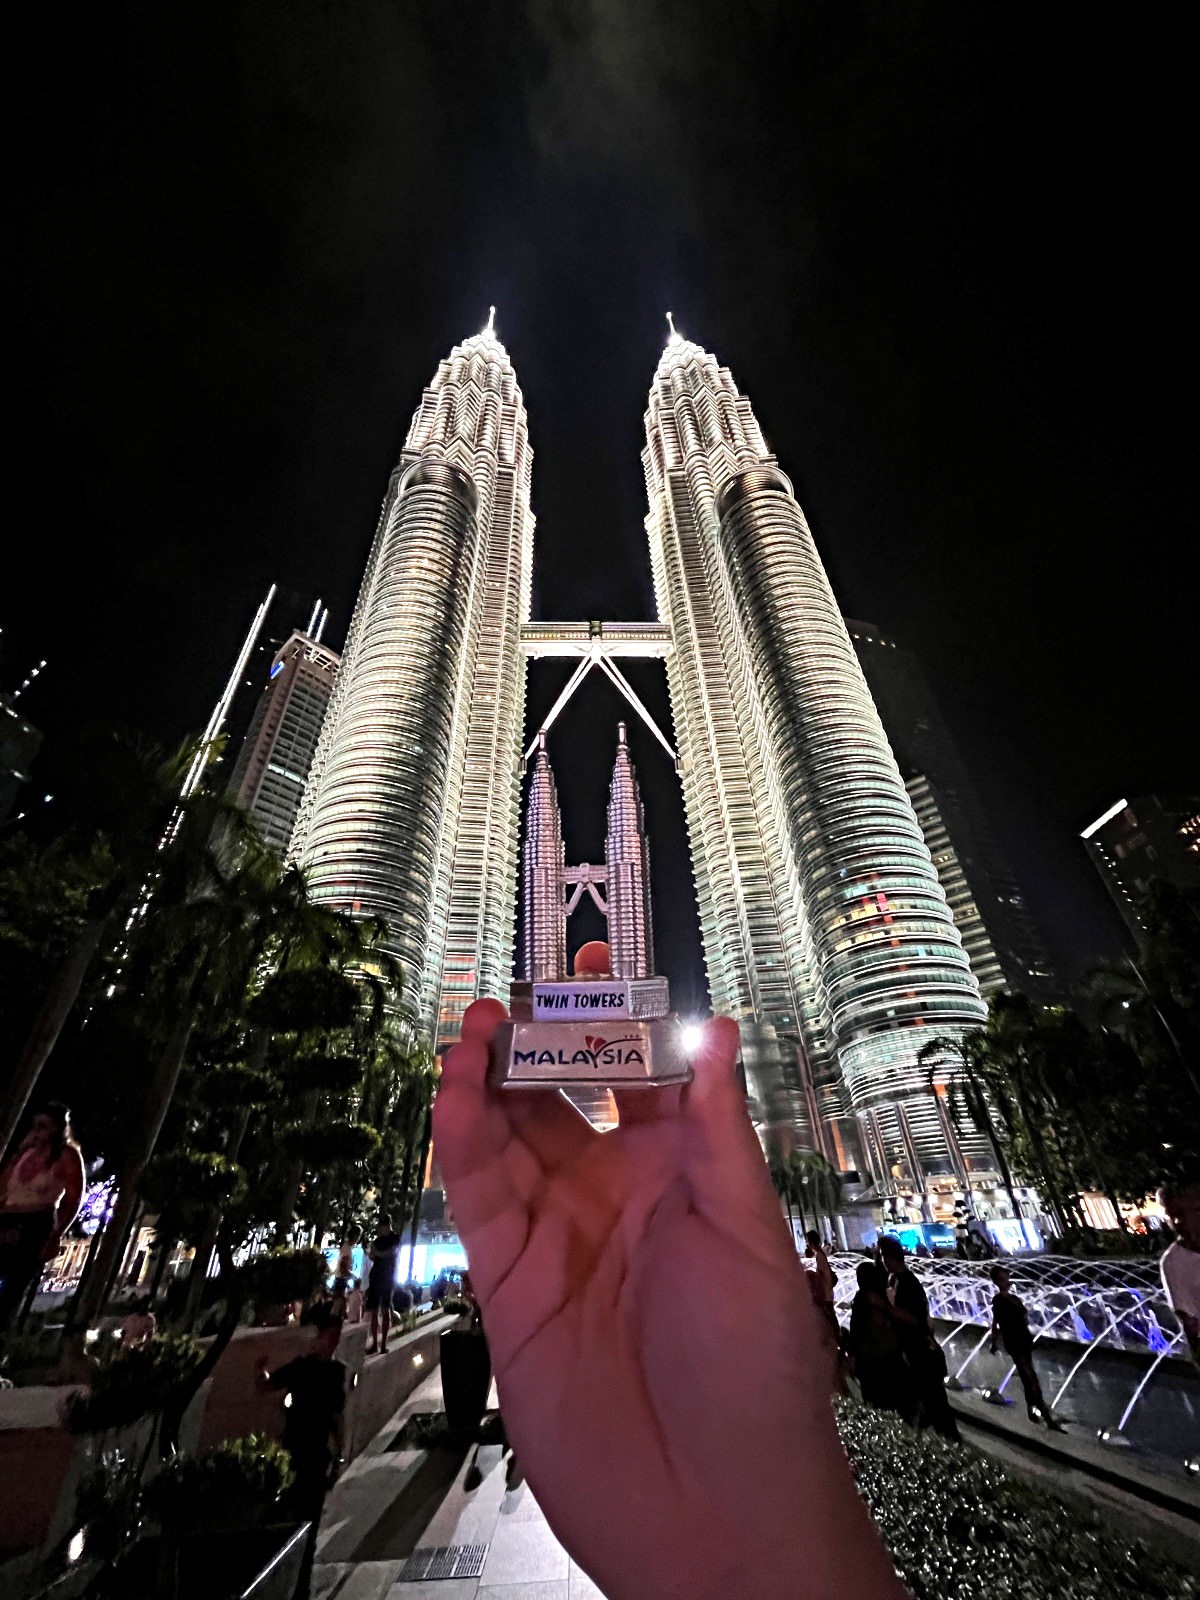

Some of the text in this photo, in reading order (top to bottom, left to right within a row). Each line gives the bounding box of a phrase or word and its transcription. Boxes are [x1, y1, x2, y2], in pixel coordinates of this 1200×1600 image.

[536, 993, 625, 1009] TWIN TOWERS
[514, 1049, 644, 1069] MALAYSIA
